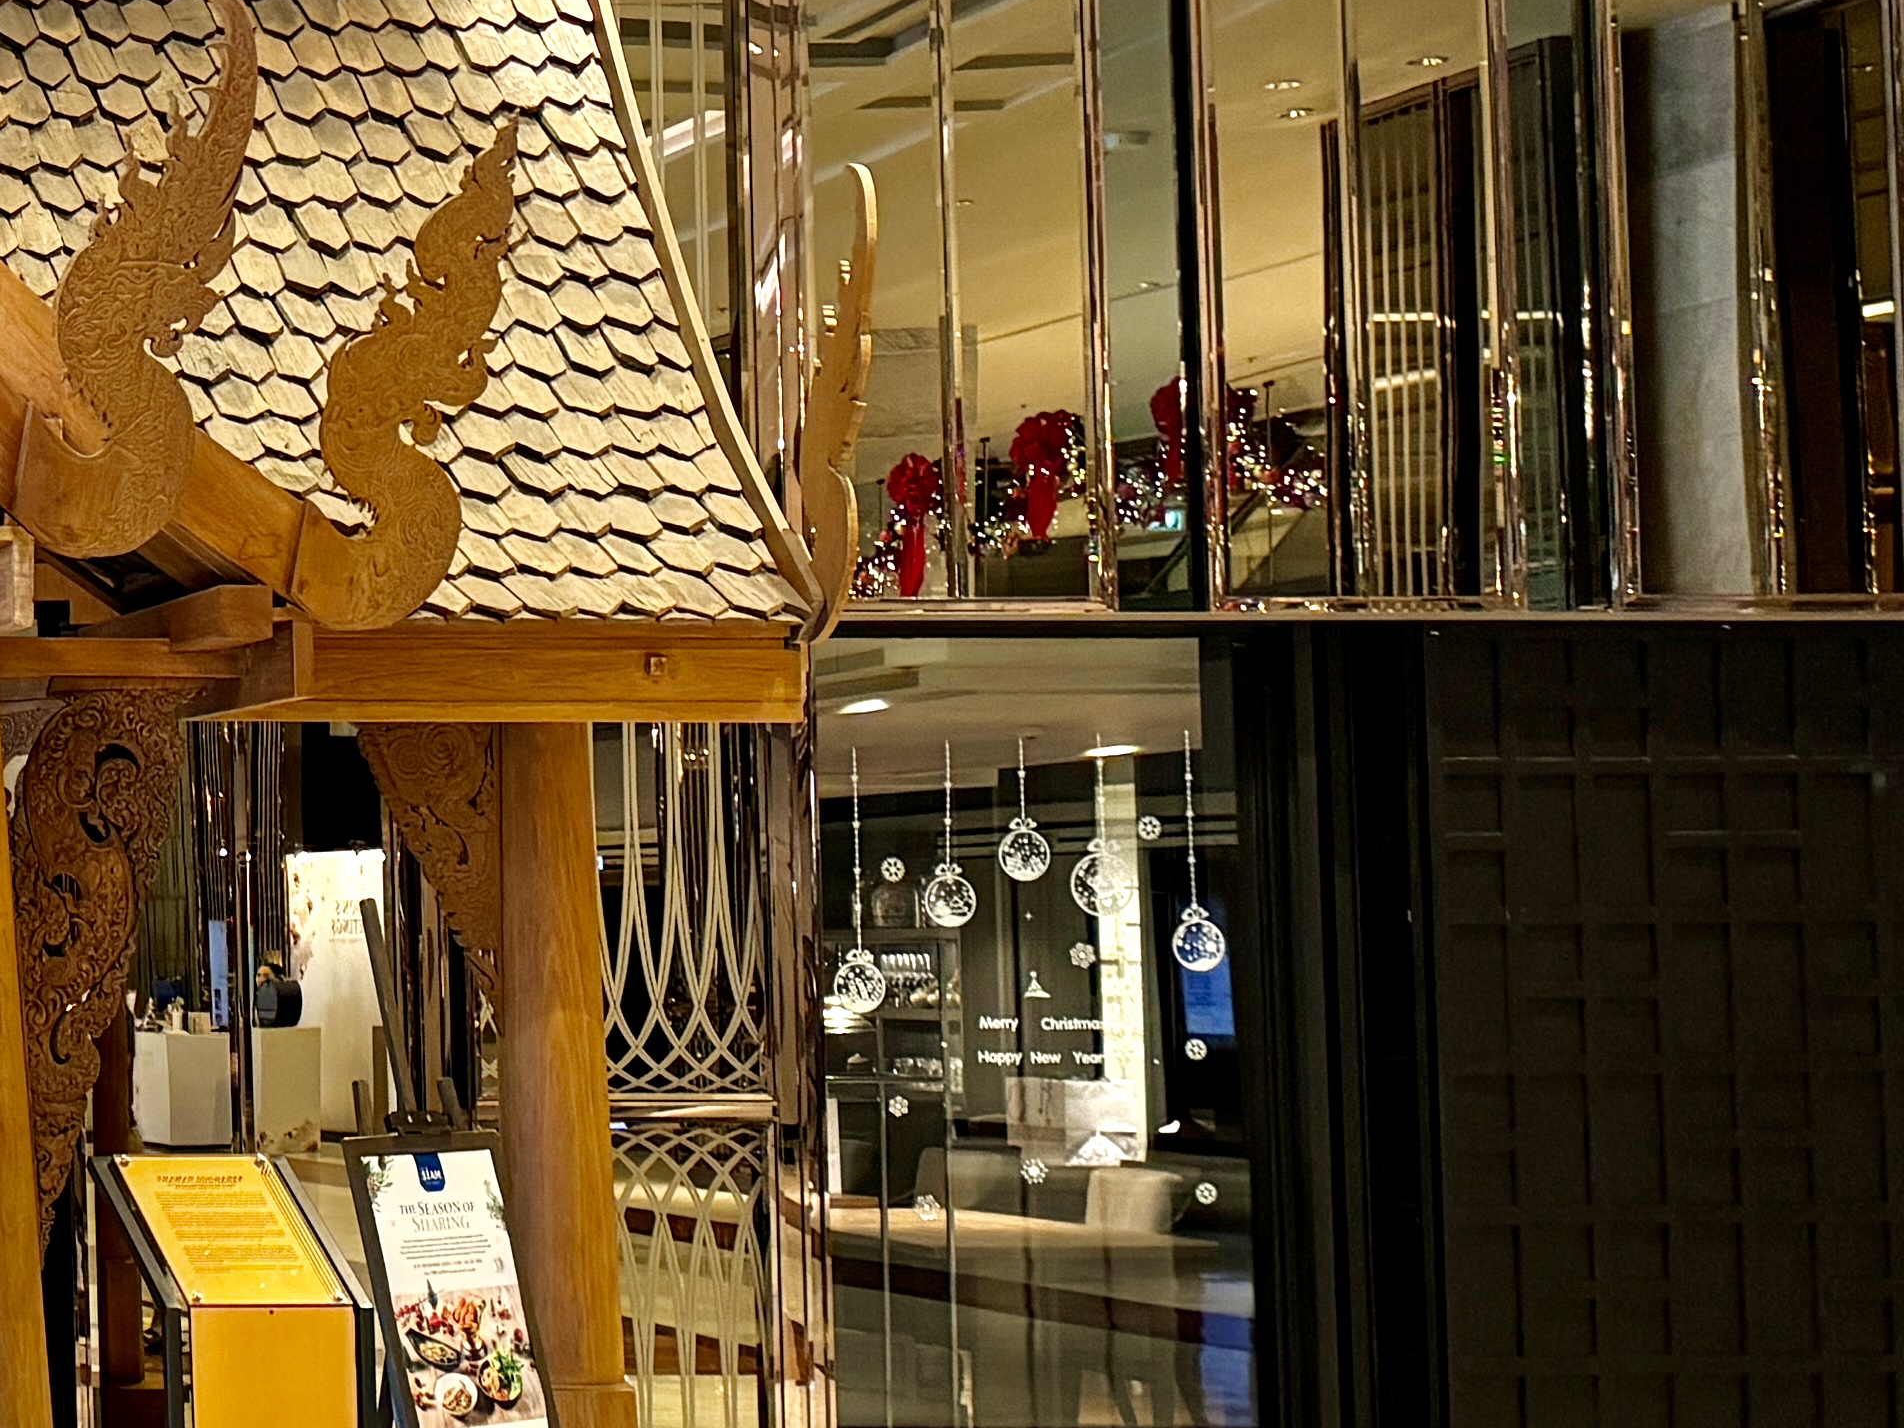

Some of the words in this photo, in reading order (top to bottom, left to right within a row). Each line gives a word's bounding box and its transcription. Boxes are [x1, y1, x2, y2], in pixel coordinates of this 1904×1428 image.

[979, 1016, 1019, 1032] Merry
[977, 1050, 1022, 1066] Happy
[1030, 1051, 1062, 1065] New
[1072, 1051, 1105, 1065] Year
[399, 1204, 416, 1215] THE
[418, 1201, 461, 1215] SEASON
[462, 1201, 475, 1213] OF
[412, 1216, 469, 1232] SHARING
